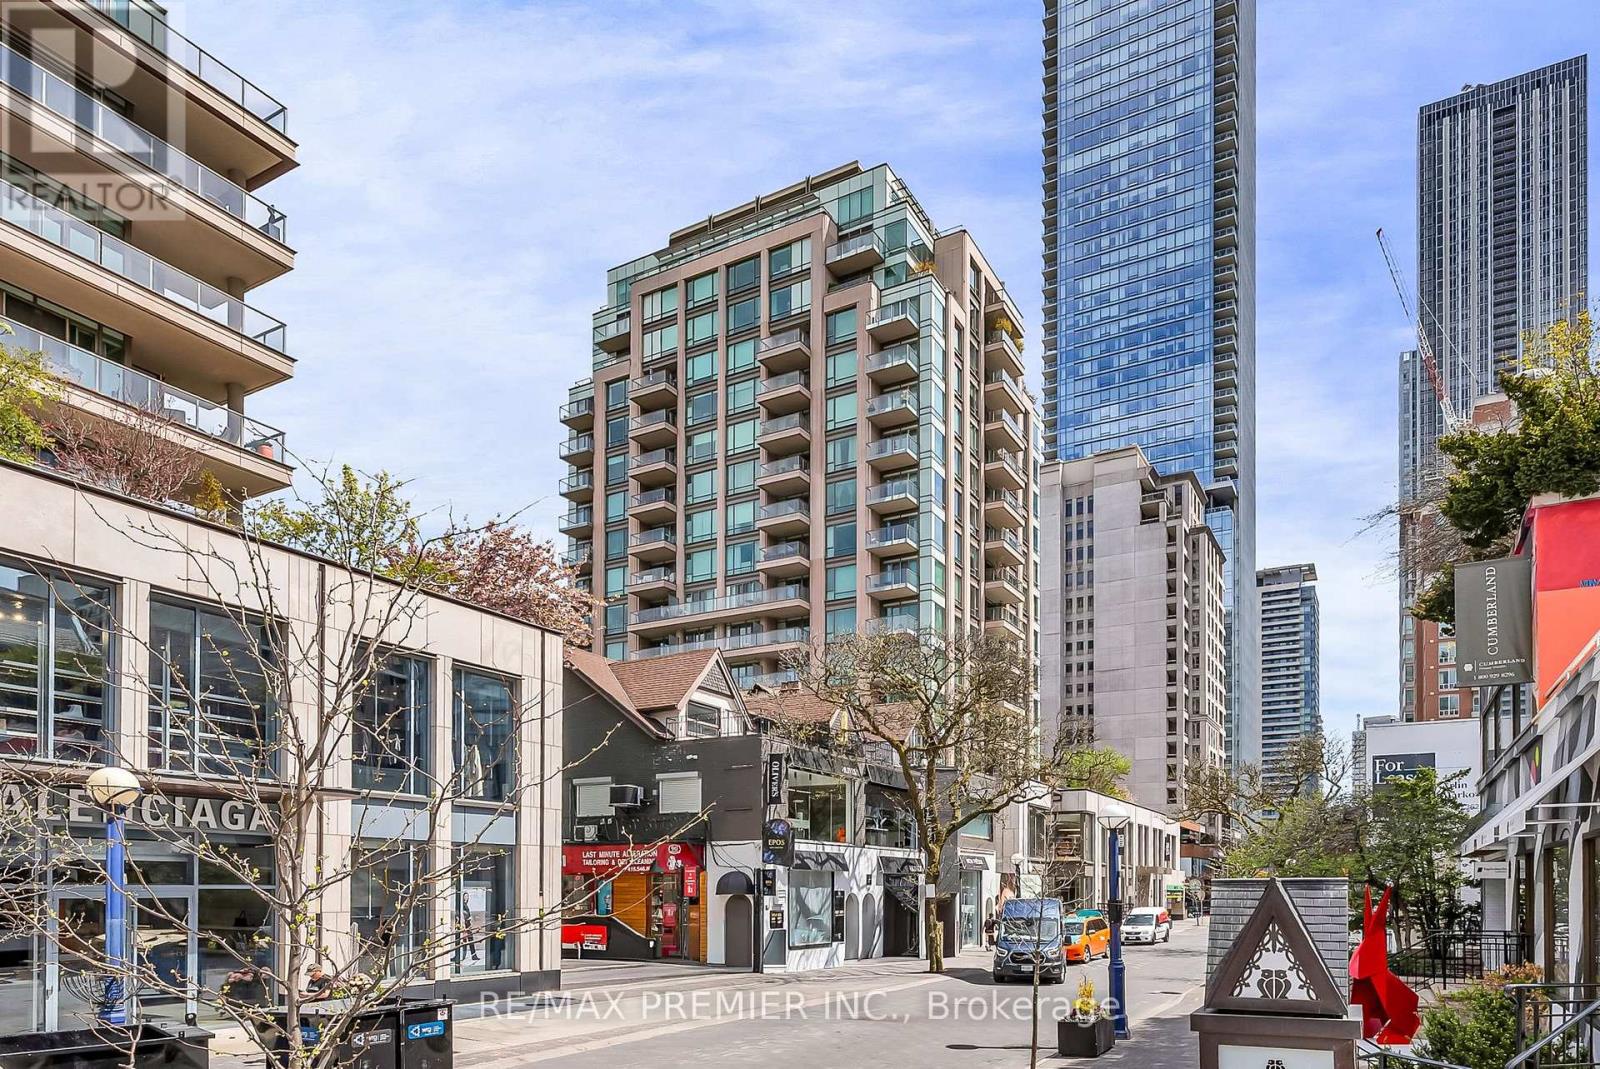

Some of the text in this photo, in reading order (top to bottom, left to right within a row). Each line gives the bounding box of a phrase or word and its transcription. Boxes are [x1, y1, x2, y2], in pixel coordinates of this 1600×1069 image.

[1486, 566, 1499, 656] CUMBERLAND
[1374, 758, 1404, 772] For
[771, 761, 780, 798] OLIVERS
[768, 839, 786, 847] EPOS
[599, 850, 620, 858] MINUTE
